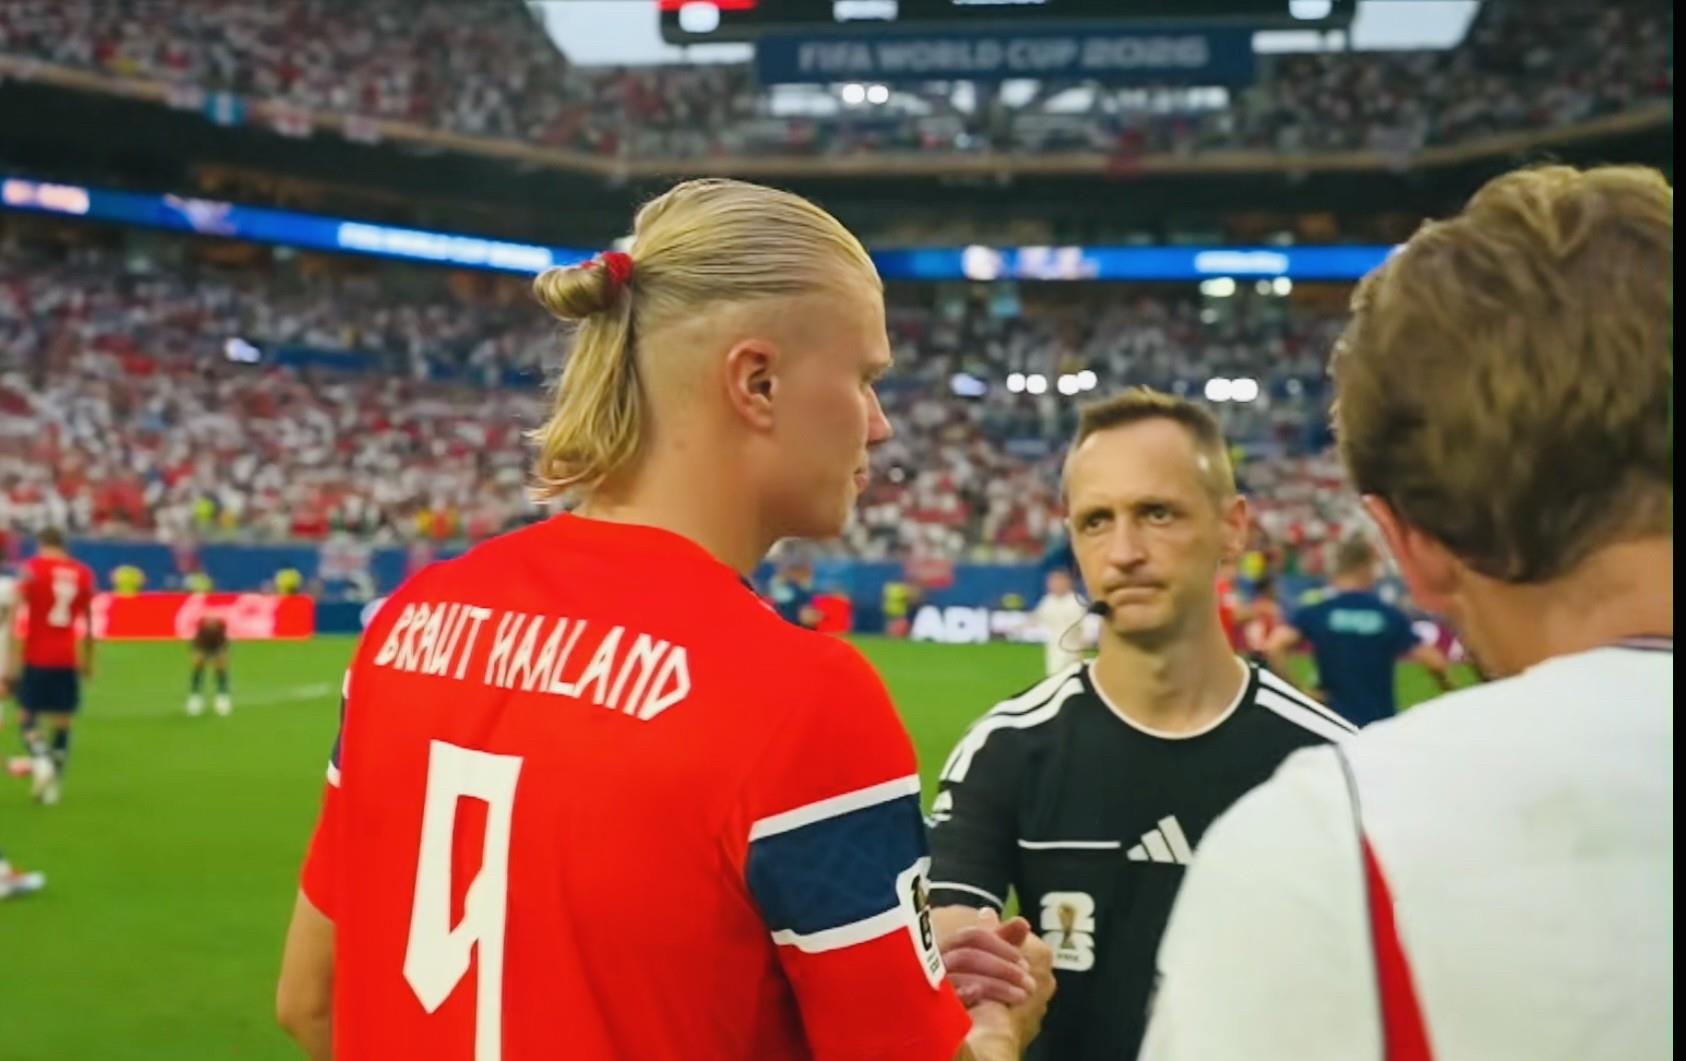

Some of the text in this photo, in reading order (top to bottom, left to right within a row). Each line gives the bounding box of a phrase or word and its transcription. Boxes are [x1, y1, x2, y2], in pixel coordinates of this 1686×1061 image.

[800, 36, 1210, 71] FIFA WORLD CUP 2026
[374, 602, 493, 680] BRAUT
[484, 611, 691, 721] HAALAND
[402, 739, 524, 1061] 9
